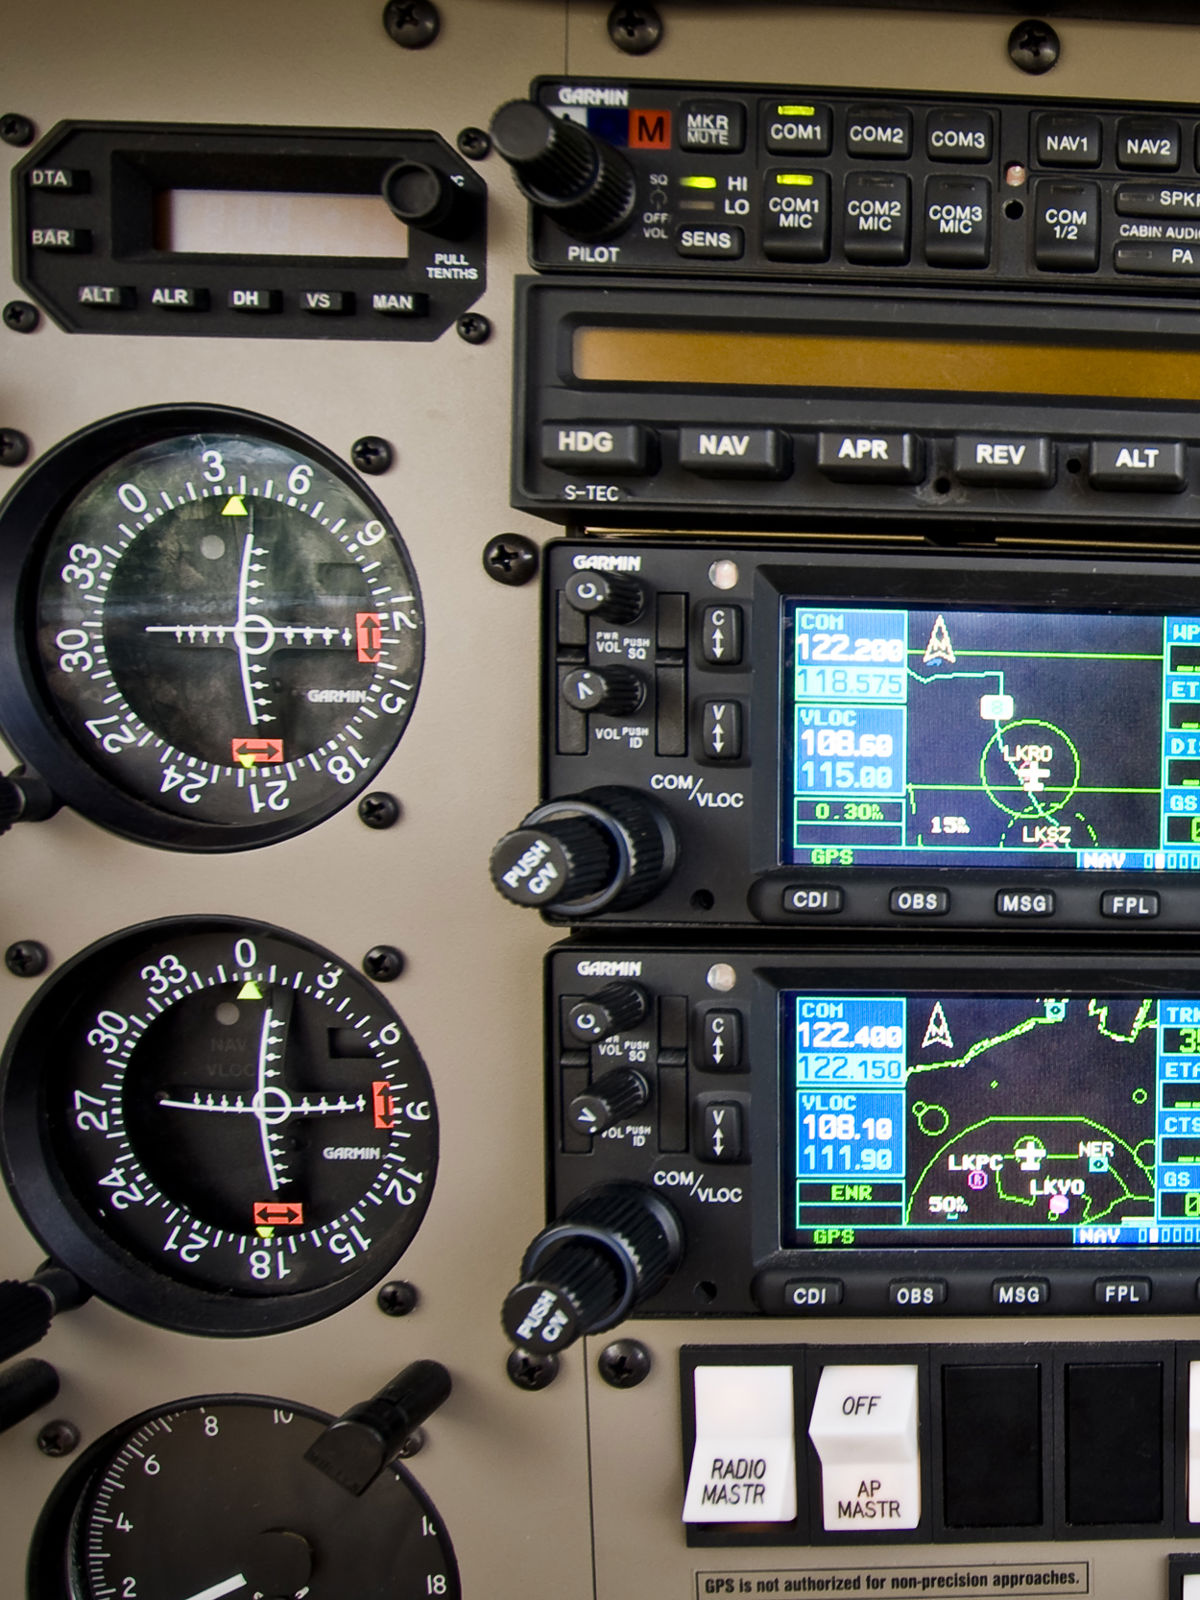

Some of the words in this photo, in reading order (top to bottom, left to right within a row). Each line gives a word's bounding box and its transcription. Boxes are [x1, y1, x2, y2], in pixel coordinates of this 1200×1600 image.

[558, 88, 628, 106] GARMIN
[688, 114, 728, 129] MKR
[771, 124, 821, 140] COM1
[850, 126, 903, 144] COM2
[931, 131, 985, 148] COM3
[1047, 136, 1088, 151] NAV1
[1127, 139, 1170, 155] NAV2
[769, 198, 819, 213] COM1
[848, 201, 901, 216] COM2
[929, 205, 982, 222] COM3
[779, 213, 812, 229] MIC
[859, 216, 891, 231] MIC
[1045, 209, 1087, 225] COM
[940, 220, 972, 234] MIC
[1120, 224, 1162, 238] CABIN
[681, 232, 731, 248] SENS
[435, 254, 468, 266] PULL
[568, 247, 620, 262] PILOT
[1172, 249, 1193, 264] PA
[426, 267, 478, 280] TENTHS
[373, 295, 412, 309] MAN
[558, 431, 613, 453] HDG
[699, 435, 749, 456] NAV
[838, 439, 889, 460] APR
[977, 444, 1026, 465] REV
[1115, 448, 1159, 468] ALT
[203, 451, 226, 482] 3
[62, 543, 102, 590] 33
[573, 555, 641, 571] GARMIN
[801, 614, 844, 631] COM
[56, 629, 93, 673] 30
[596, 641, 622, 653] VOL
[623, 638, 650, 648] PUSH
[798, 669, 902, 694] 118.575
[801, 710, 856, 726] VLOC
[85, 715, 137, 754] 27
[801, 729, 893, 757] 108.60
[1004, 745, 1052, 762] LKRO
[802, 761, 893, 788] 115.00
[160, 765, 208, 803] 24
[811, 850, 854, 865] GPS
[793, 892, 828, 907] CDI
[898, 894, 937, 910] OBS
[1003, 896, 1046, 912] MSG
[1113, 897, 1149, 913] FPL
[140, 954, 188, 994] 33
[577, 961, 642, 976] GARMIN
[798, 1022, 902, 1048] 122.400
[799, 1055, 900, 1079] 122.150
[74, 1090, 109, 1132] 27
[803, 1114, 892, 1140] 108.10
[803, 1145, 892, 1170] 111.90
[1079, 1141, 1114, 1158] NER
[948, 1154, 1003, 1170] LKPC
[831, 1185, 872, 1200] ENR
[1030, 1179, 1085, 1195] LKVO
[249, 1251, 291, 1279] 18
[793, 1287, 827, 1304] CDI
[897, 1288, 934, 1304] OBS
[999, 1286, 1040, 1303] MSG
[1106, 1285, 1139, 1302] FPL
[842, 1395, 881, 1416] OFF
[204, 1415, 219, 1436] 8
[711, 1458, 766, 1480] RADIO
[701, 1483, 766, 1505] MASTR
[857, 1480, 881, 1498] AP
[838, 1500, 900, 1519] MASTR
[426, 1574, 446, 1595] 18
[705, 1578, 735, 1594] GPS
[739, 1578, 752, 1593] is
[756, 1578, 780, 1593] not
[784, 1575, 861, 1592] authorized
[866, 1575, 886, 1590] for
[891, 1572, 988, 1592] non-precision
[993, 1570, 1080, 1591] approaches.
